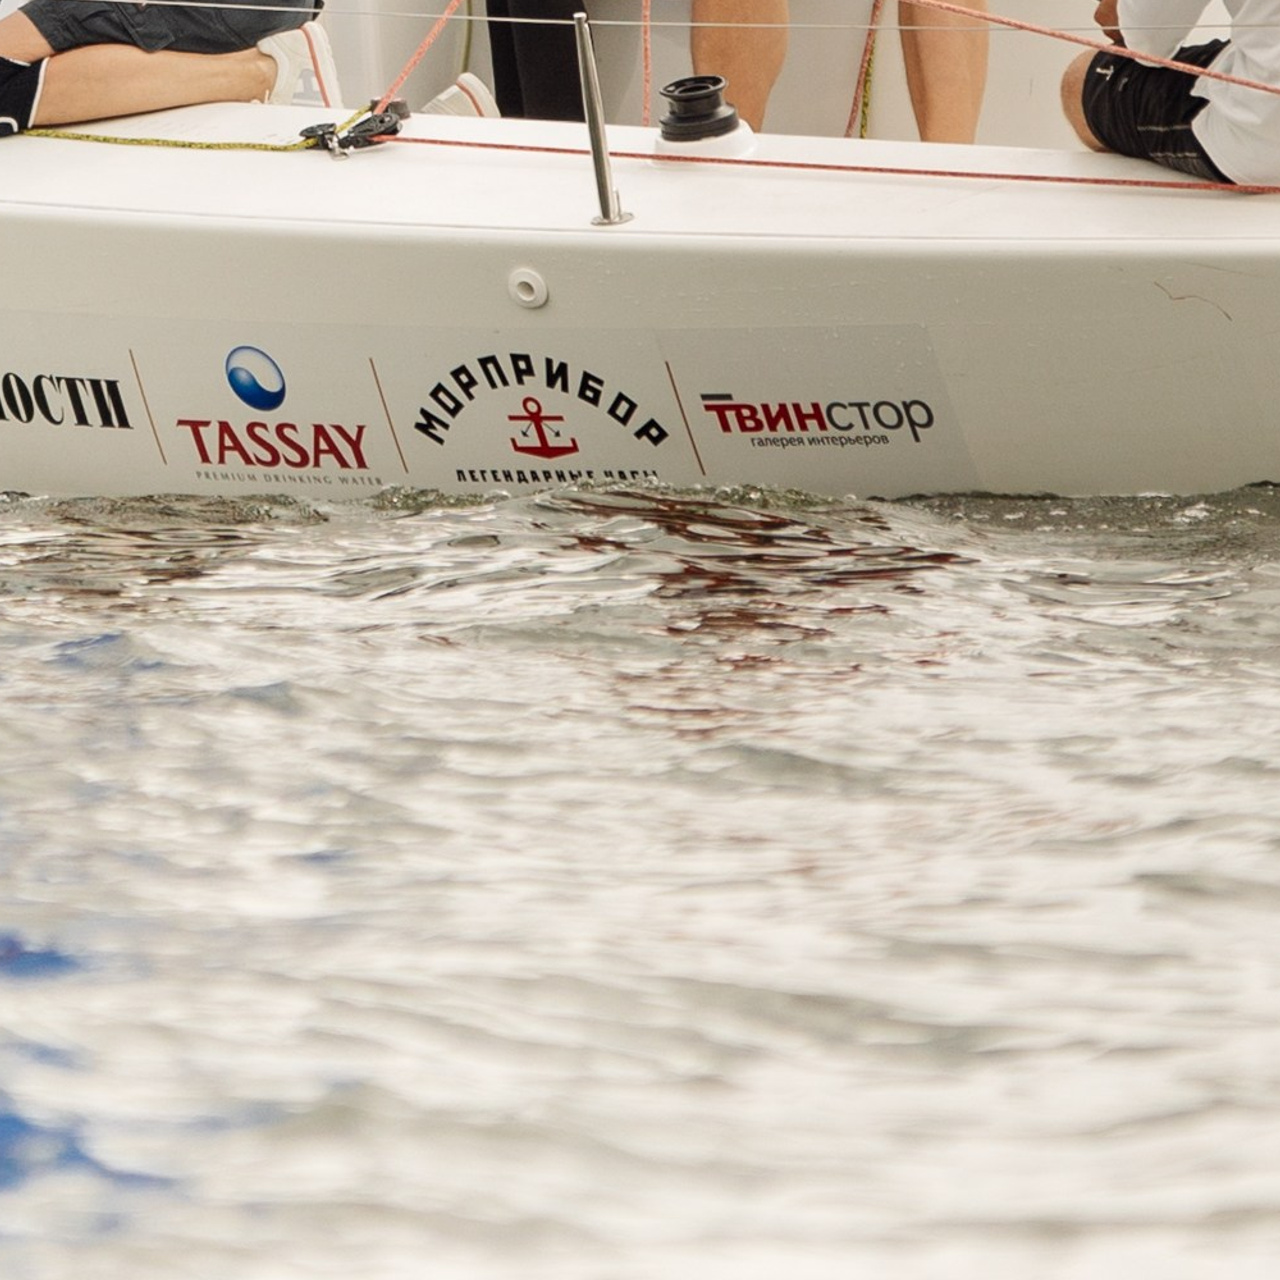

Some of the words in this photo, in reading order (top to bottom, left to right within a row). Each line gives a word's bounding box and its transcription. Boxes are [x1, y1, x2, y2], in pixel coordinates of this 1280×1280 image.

[414, 353, 669, 446] МОРПРИБОР
[176, 419, 369, 470] TASSAY
[751, 436, 804, 450] галерея
[807, 434, 889, 447] интерьеров
[196, 471, 257, 483] PREMIUM
[263, 474, 333, 485] DRINKING
[338, 476, 383, 486] WATER
